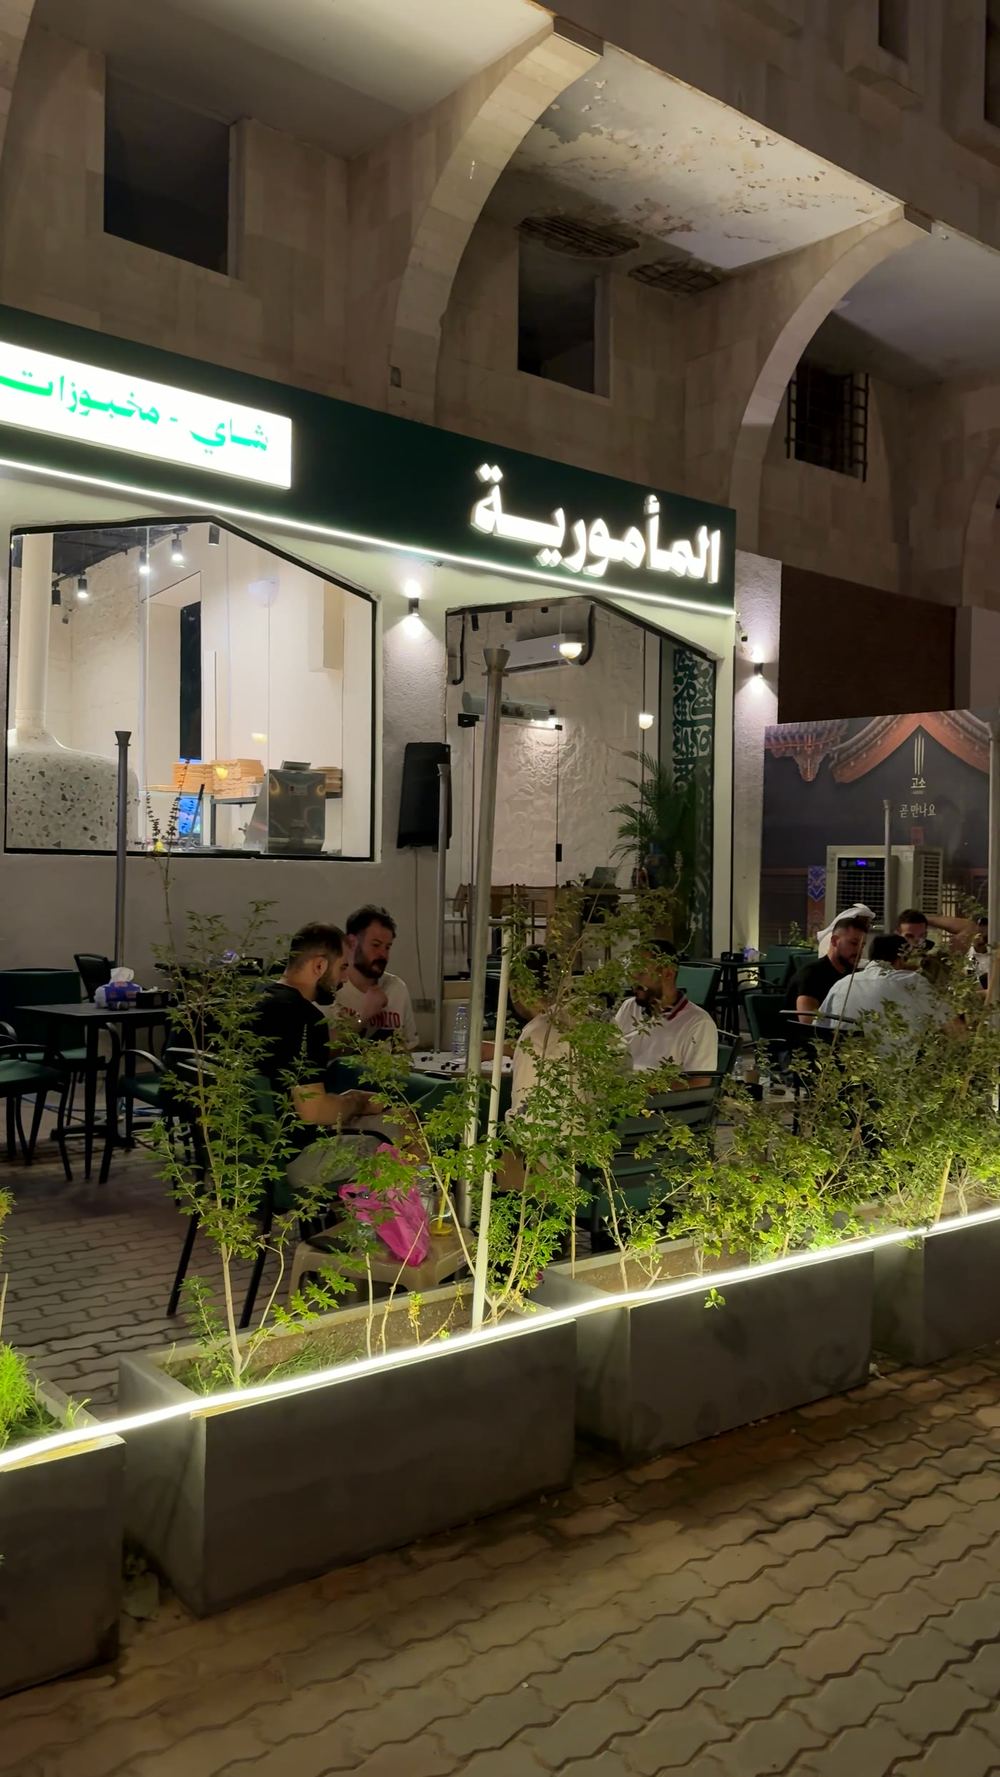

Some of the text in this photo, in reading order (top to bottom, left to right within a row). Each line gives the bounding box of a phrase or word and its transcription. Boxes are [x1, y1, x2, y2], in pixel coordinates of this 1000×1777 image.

[0, 370, 160, 425] مخبوزات
[190, 418, 268, 455] شاي
[470, 463, 721, 584] المأمورية
[910, 777, 927, 789] 고소
